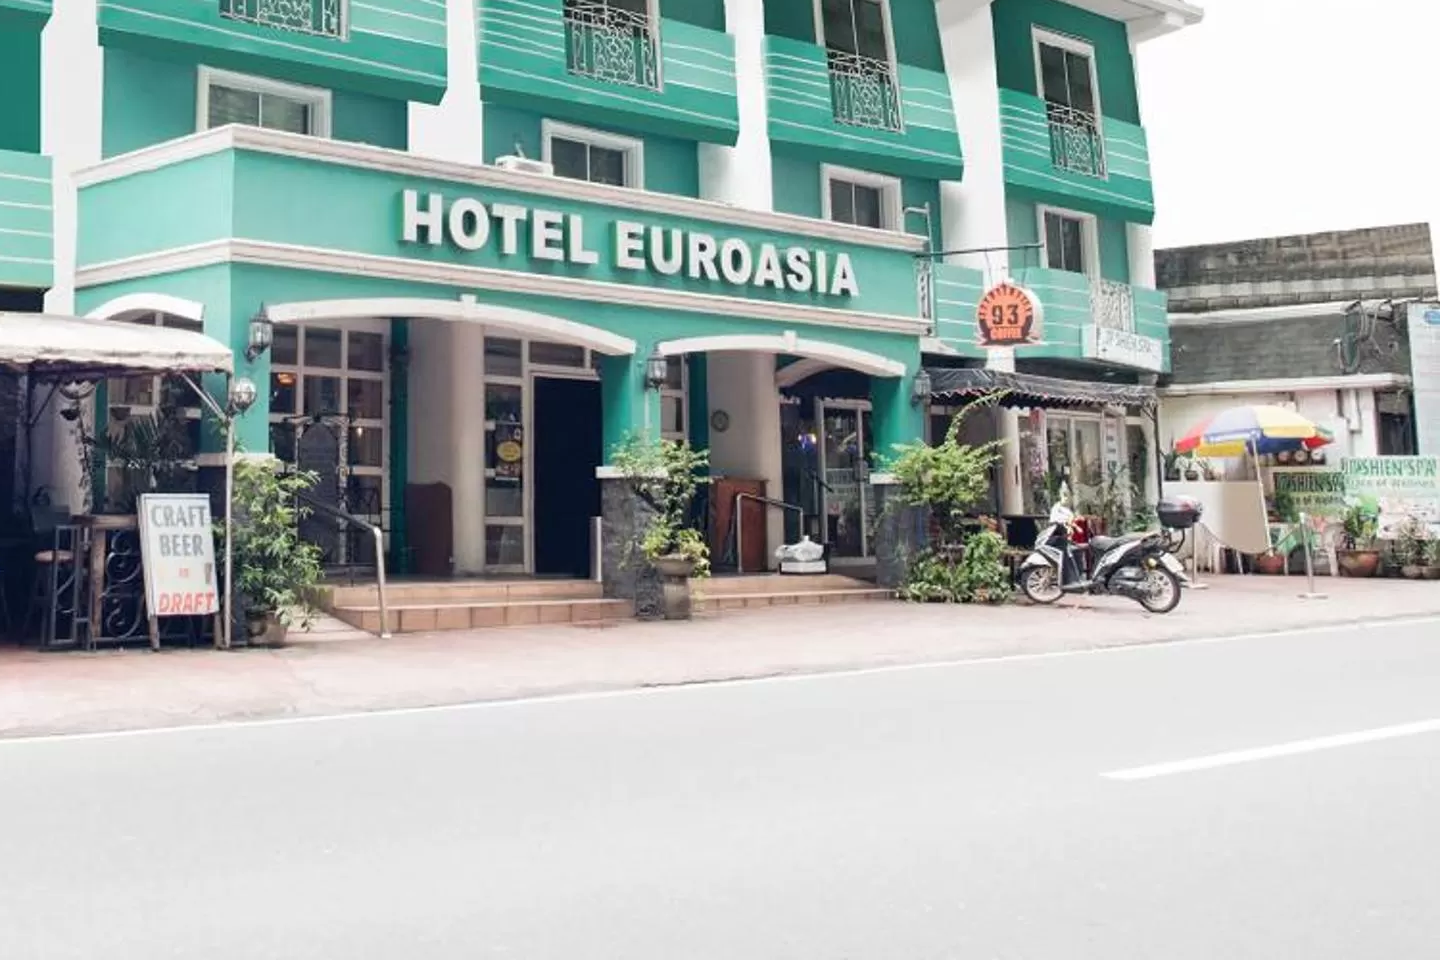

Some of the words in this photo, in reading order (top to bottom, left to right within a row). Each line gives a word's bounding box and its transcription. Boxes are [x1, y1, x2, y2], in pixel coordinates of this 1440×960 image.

[401, 188, 599, 265] HOTEL
[613, 219, 860, 297] EUROASIA
[992, 304, 1019, 325] 93
[151, 504, 207, 528] CRAFT
[159, 533, 205, 557] BEER
[158, 592, 216, 614] DRAFT
